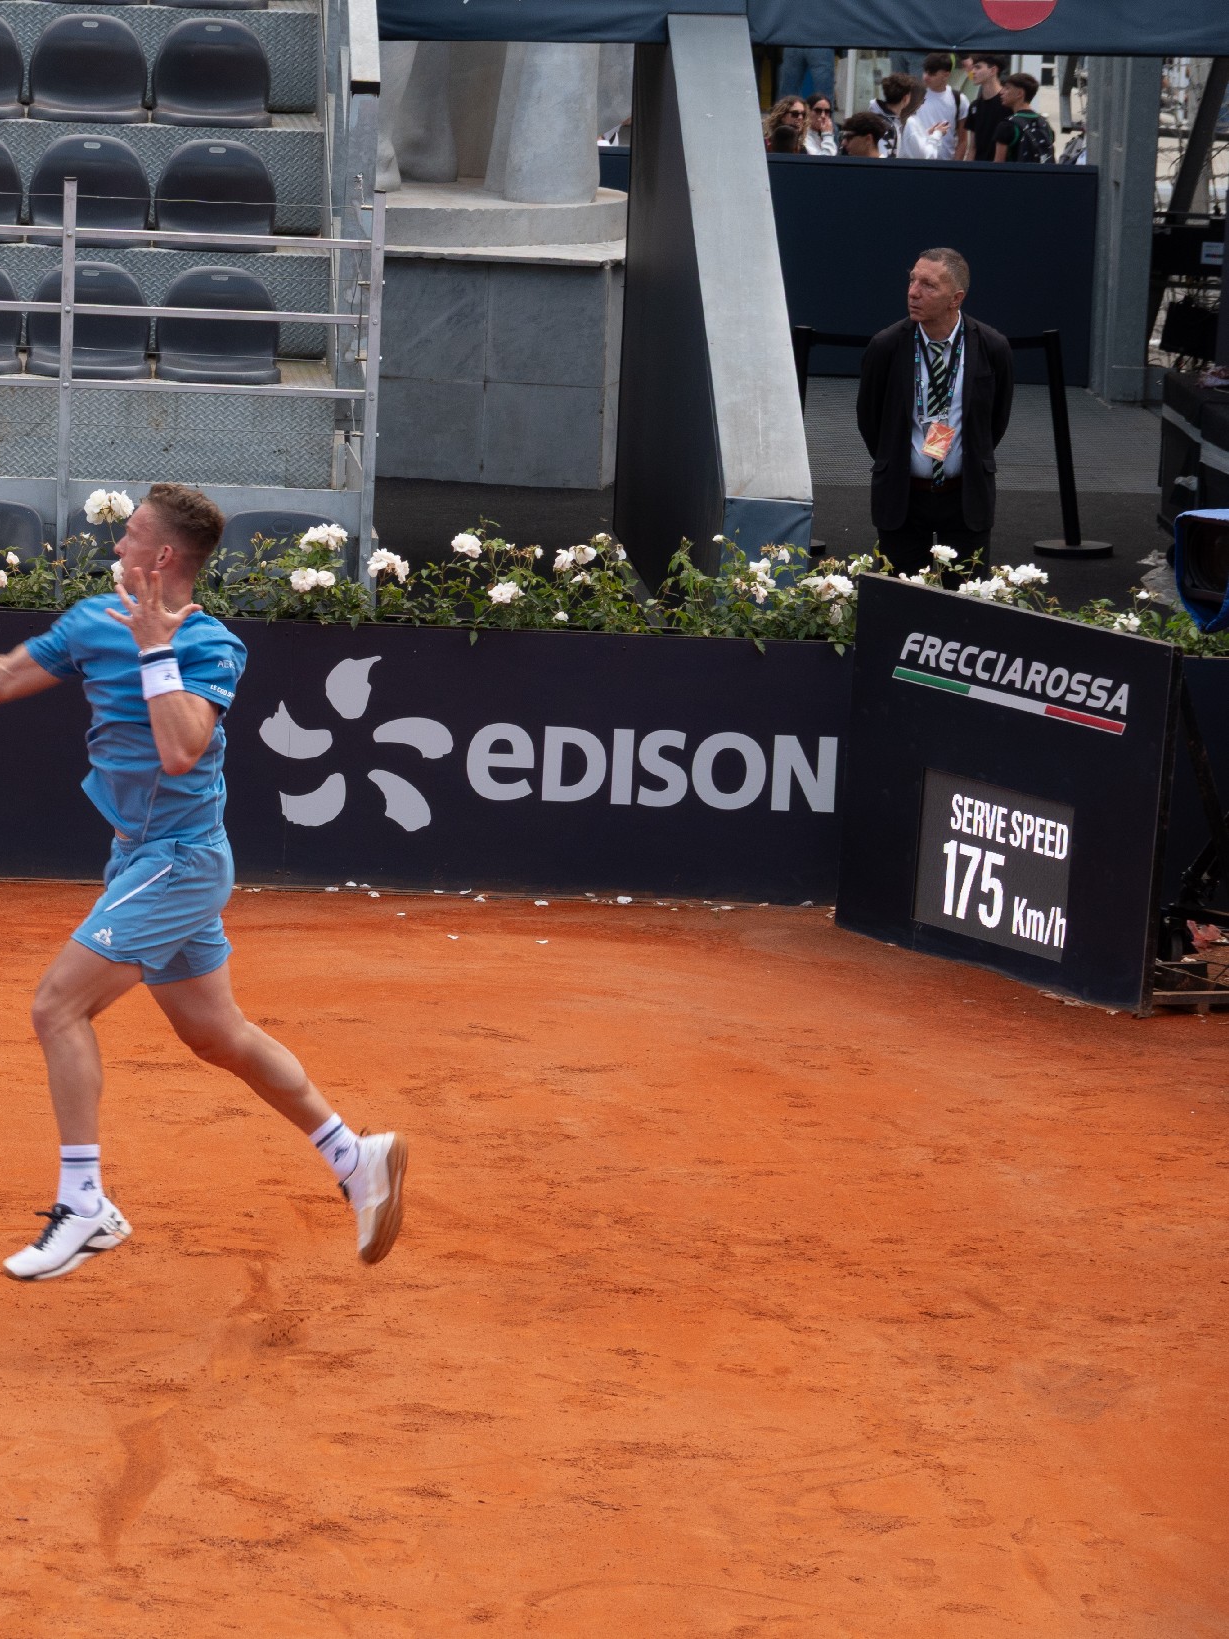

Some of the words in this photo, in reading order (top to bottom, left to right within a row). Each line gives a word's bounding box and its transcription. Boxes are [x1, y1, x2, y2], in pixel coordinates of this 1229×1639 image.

[900, 632, 1129, 715] FRECCIAROSSA
[466, 722, 838, 813] eDISON
[950, 794, 1008, 843] SERVE
[1009, 811, 1069, 860] SPEED
[943, 840, 1006, 928] 175
[1011, 896, 1067, 948] Km/h
